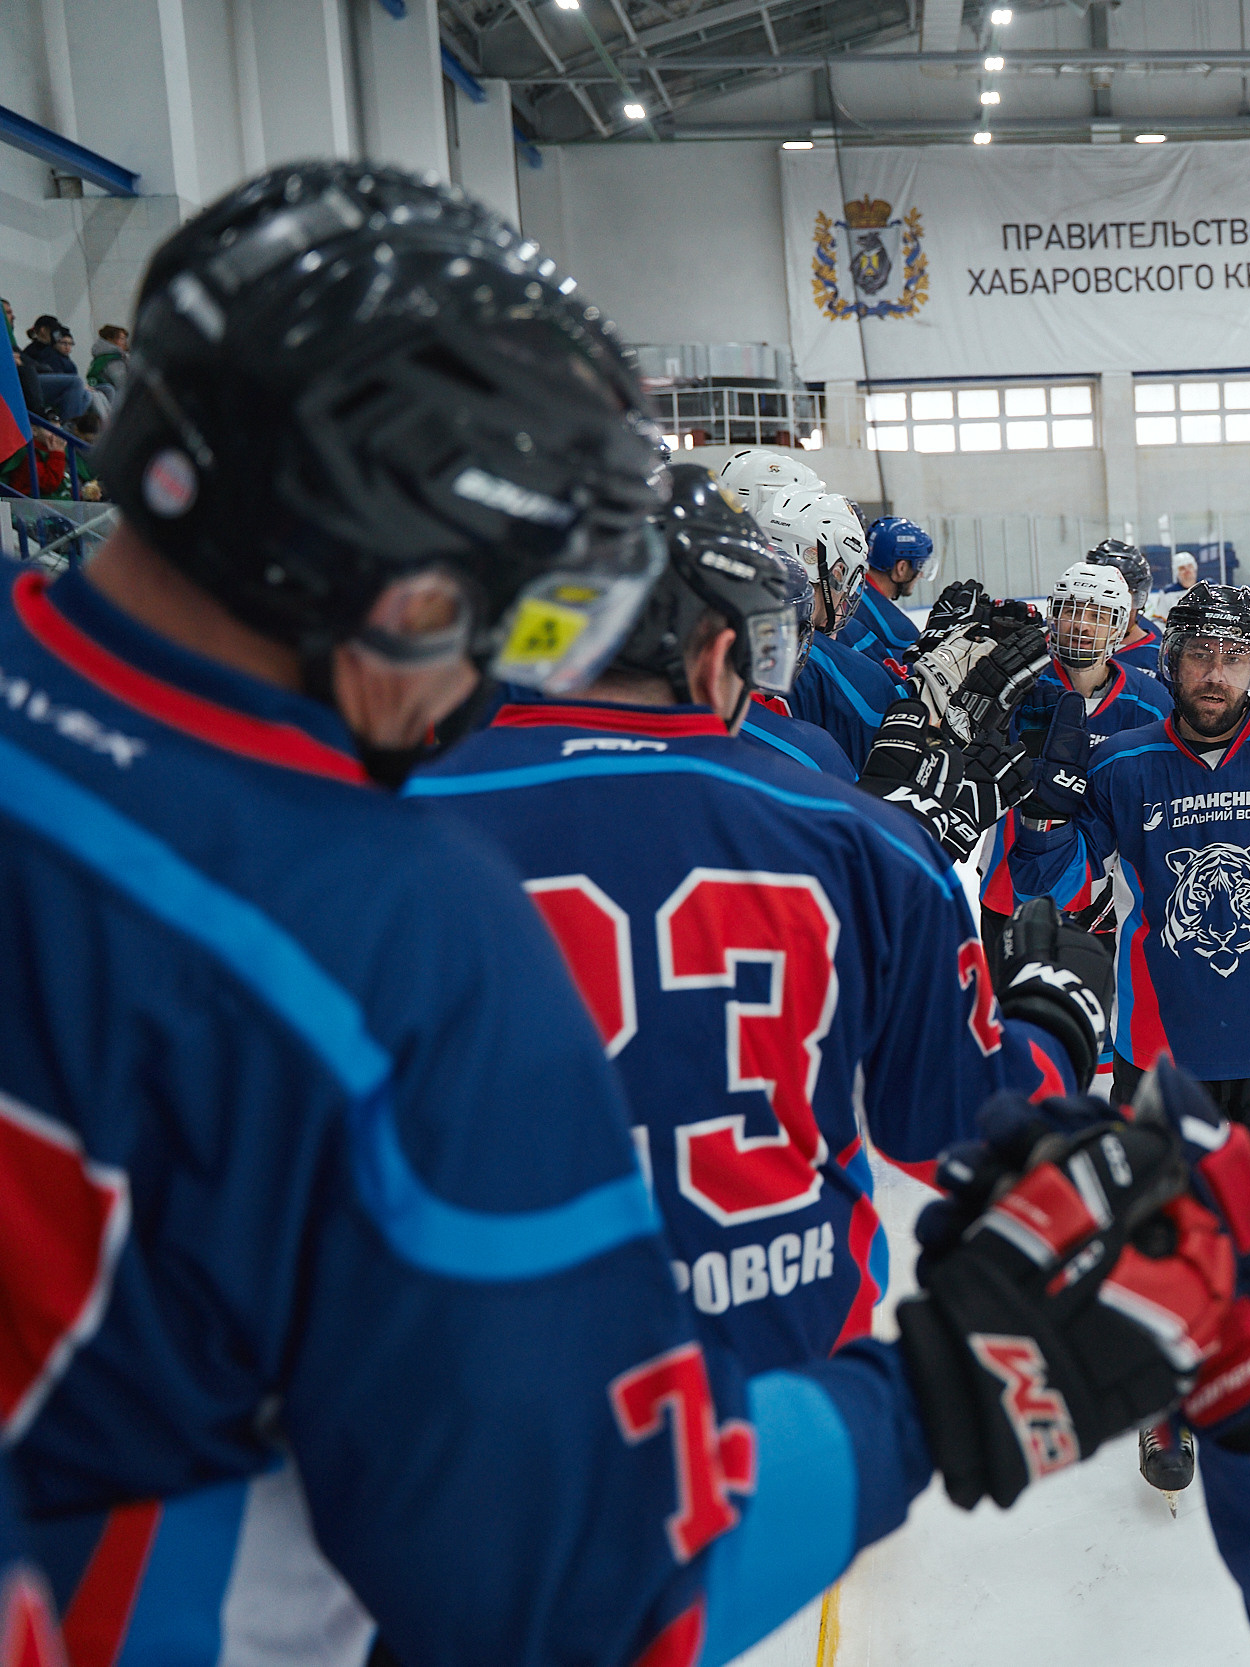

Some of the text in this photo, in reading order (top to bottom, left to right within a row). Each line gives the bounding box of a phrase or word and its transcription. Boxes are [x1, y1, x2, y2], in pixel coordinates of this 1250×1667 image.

[967, 263, 1215, 296] ХАБАРОВСКОГО
[1073, 581, 1098, 589] CCM
[1172, 806, 1233, 828] ДАЛЬНИЙ
